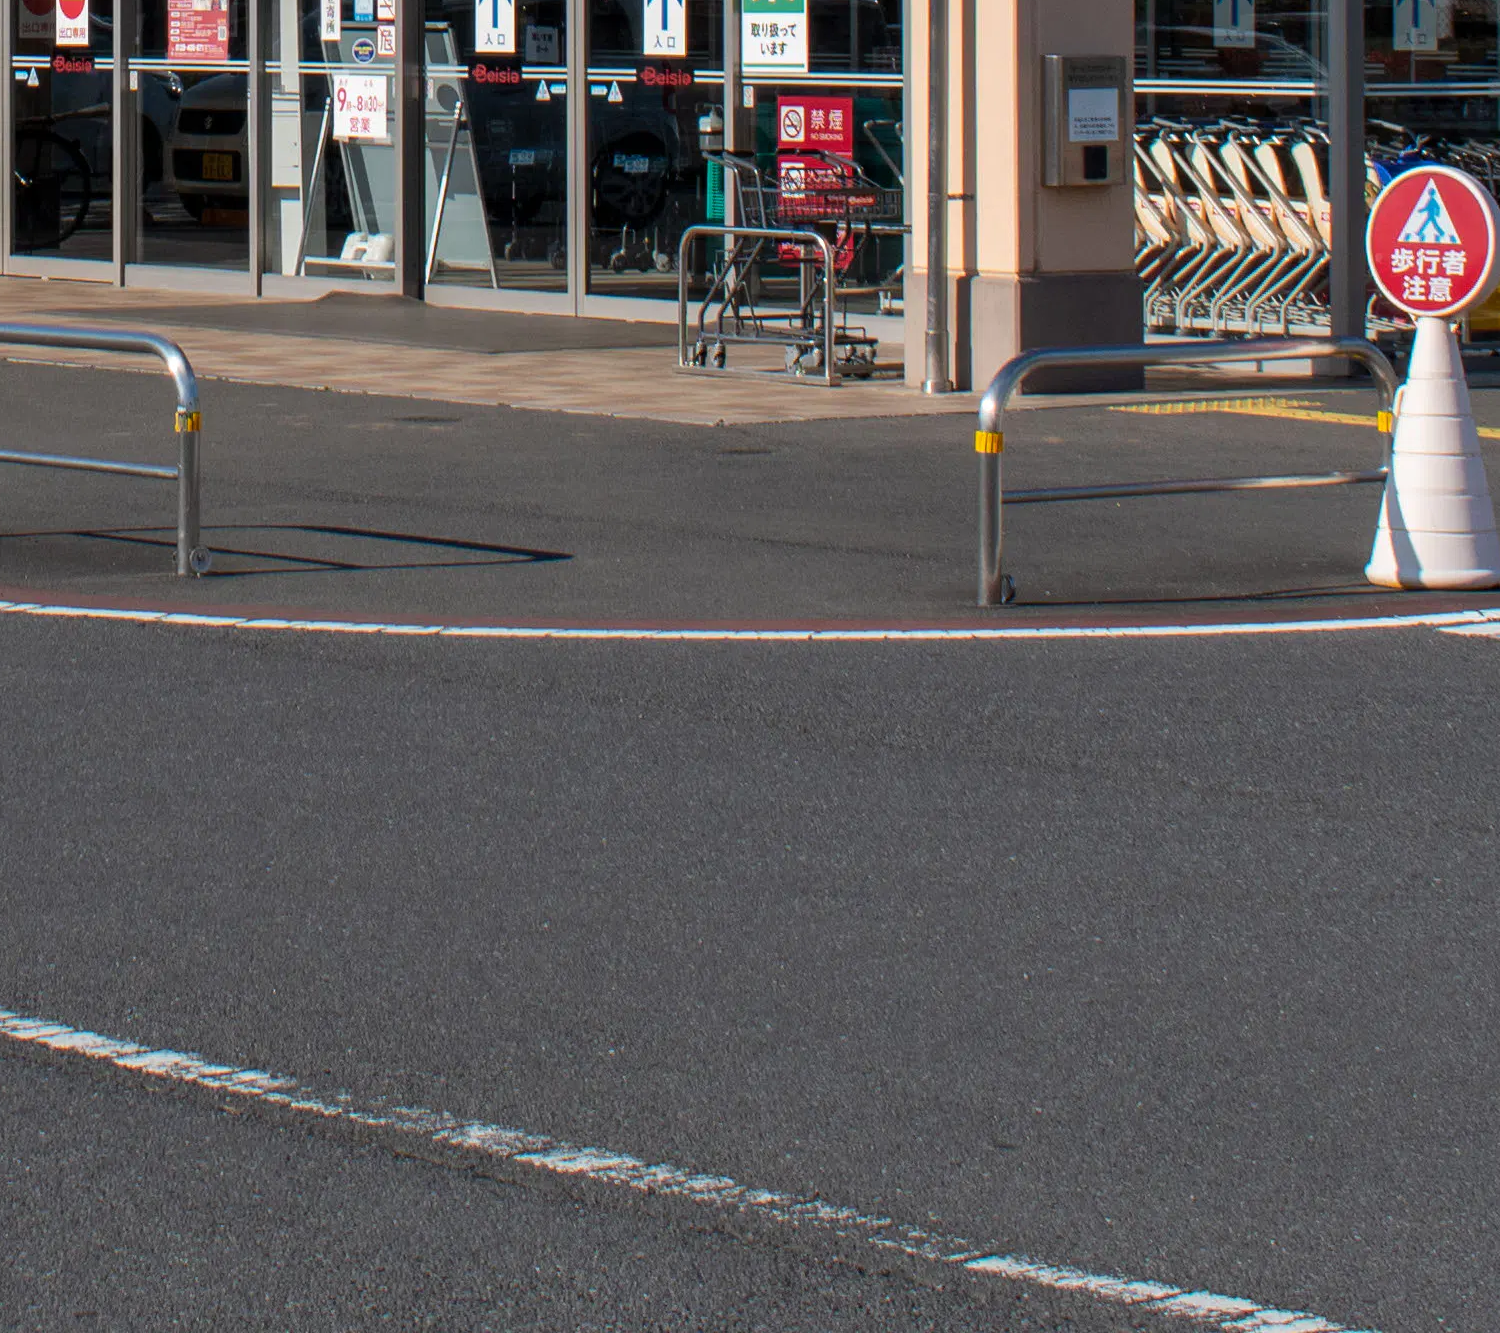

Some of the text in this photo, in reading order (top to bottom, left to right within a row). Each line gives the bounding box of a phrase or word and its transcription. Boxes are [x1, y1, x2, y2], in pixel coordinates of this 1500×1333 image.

[58, 27, 86, 40] 出口専用
[750, 22, 798, 38] 取り扱って
[484, 33, 506, 46] 入口
[653, 35, 676, 49] 入口
[760, 41, 788, 57] います
[52, 55, 93, 73] Beisia
[471, 63, 520, 84] Beisia
[640, 65, 692, 87] Beisia
[810, 109, 844, 131] 禁煙
[1390, 247, 1468, 277] 歩行者
[1401, 275, 1453, 303] 注意
